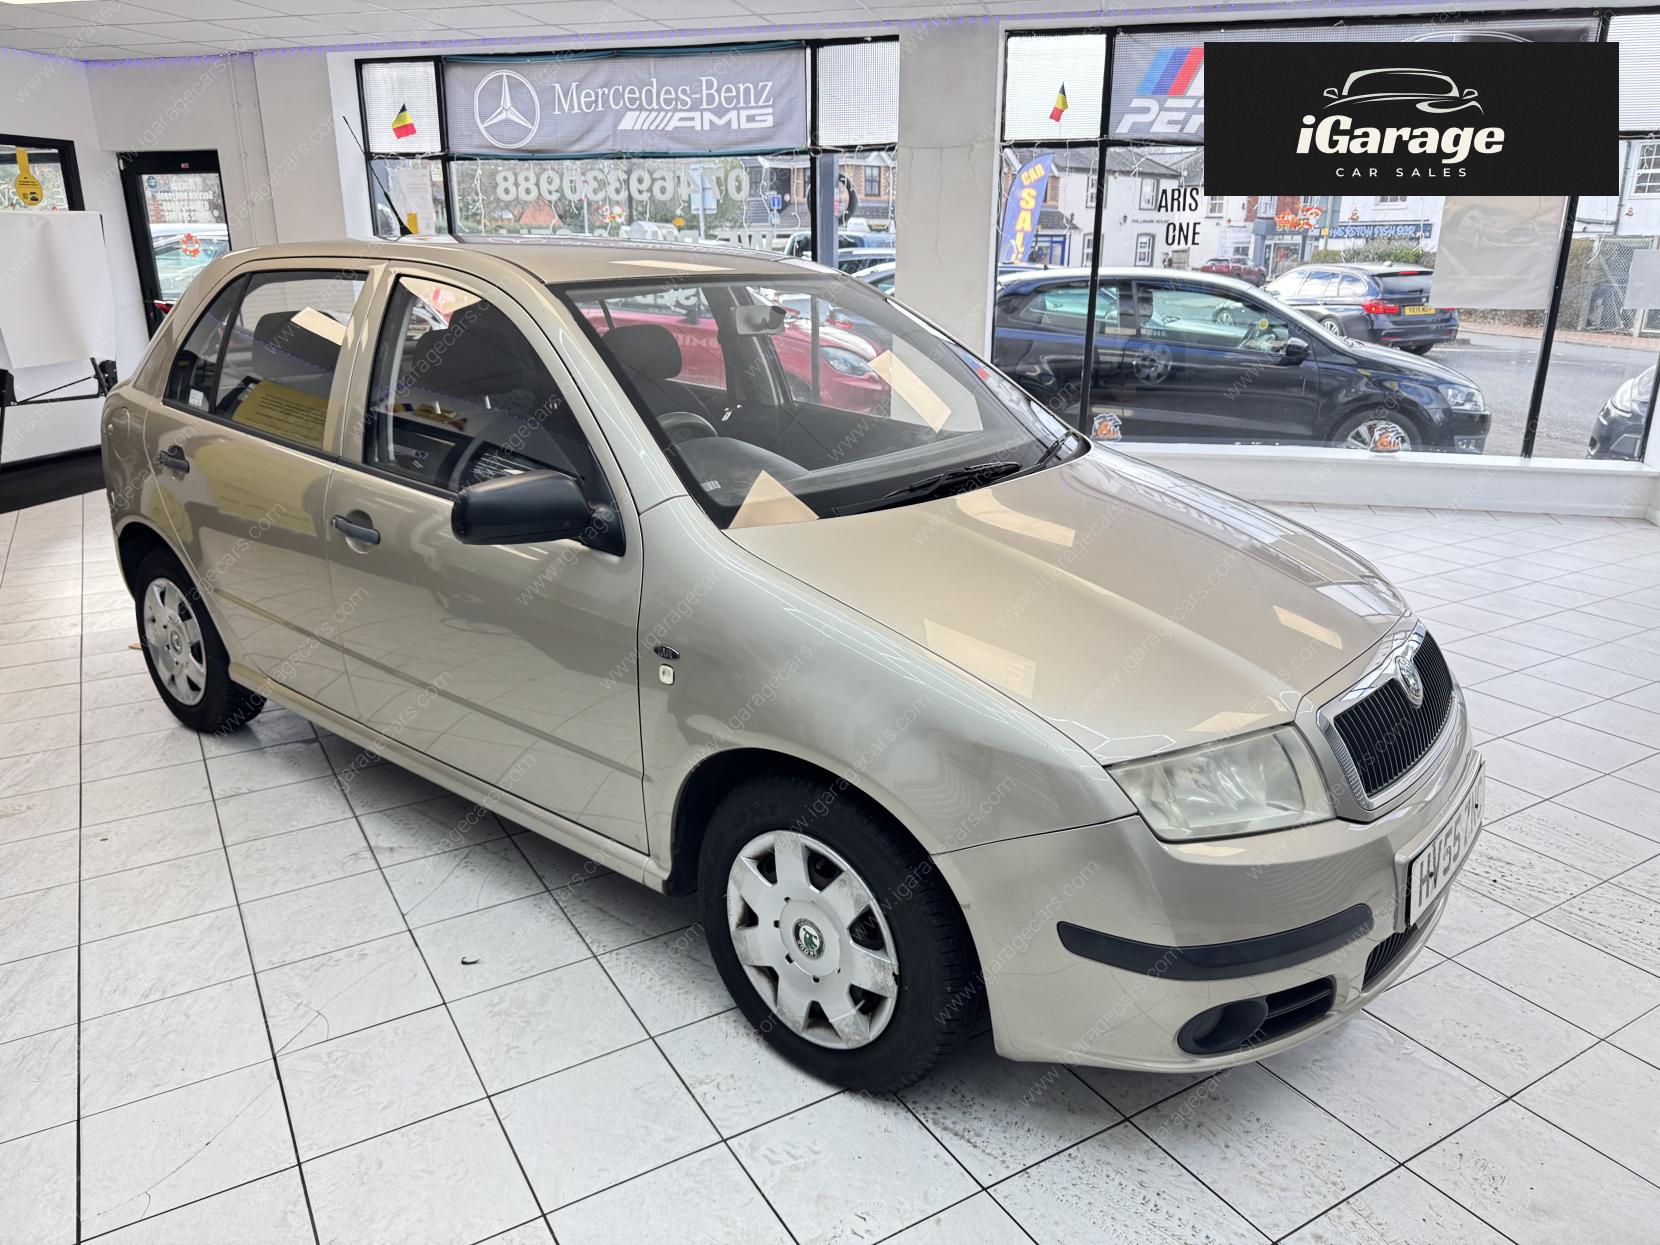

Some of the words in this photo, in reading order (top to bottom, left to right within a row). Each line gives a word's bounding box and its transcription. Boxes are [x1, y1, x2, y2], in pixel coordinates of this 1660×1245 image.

[552, 76, 773, 115] Mercedes-Benz
[1020, 163, 1045, 186] CAR
[1157, 187, 1199, 213] ARIS
[1165, 222, 1201, 246] ONE
